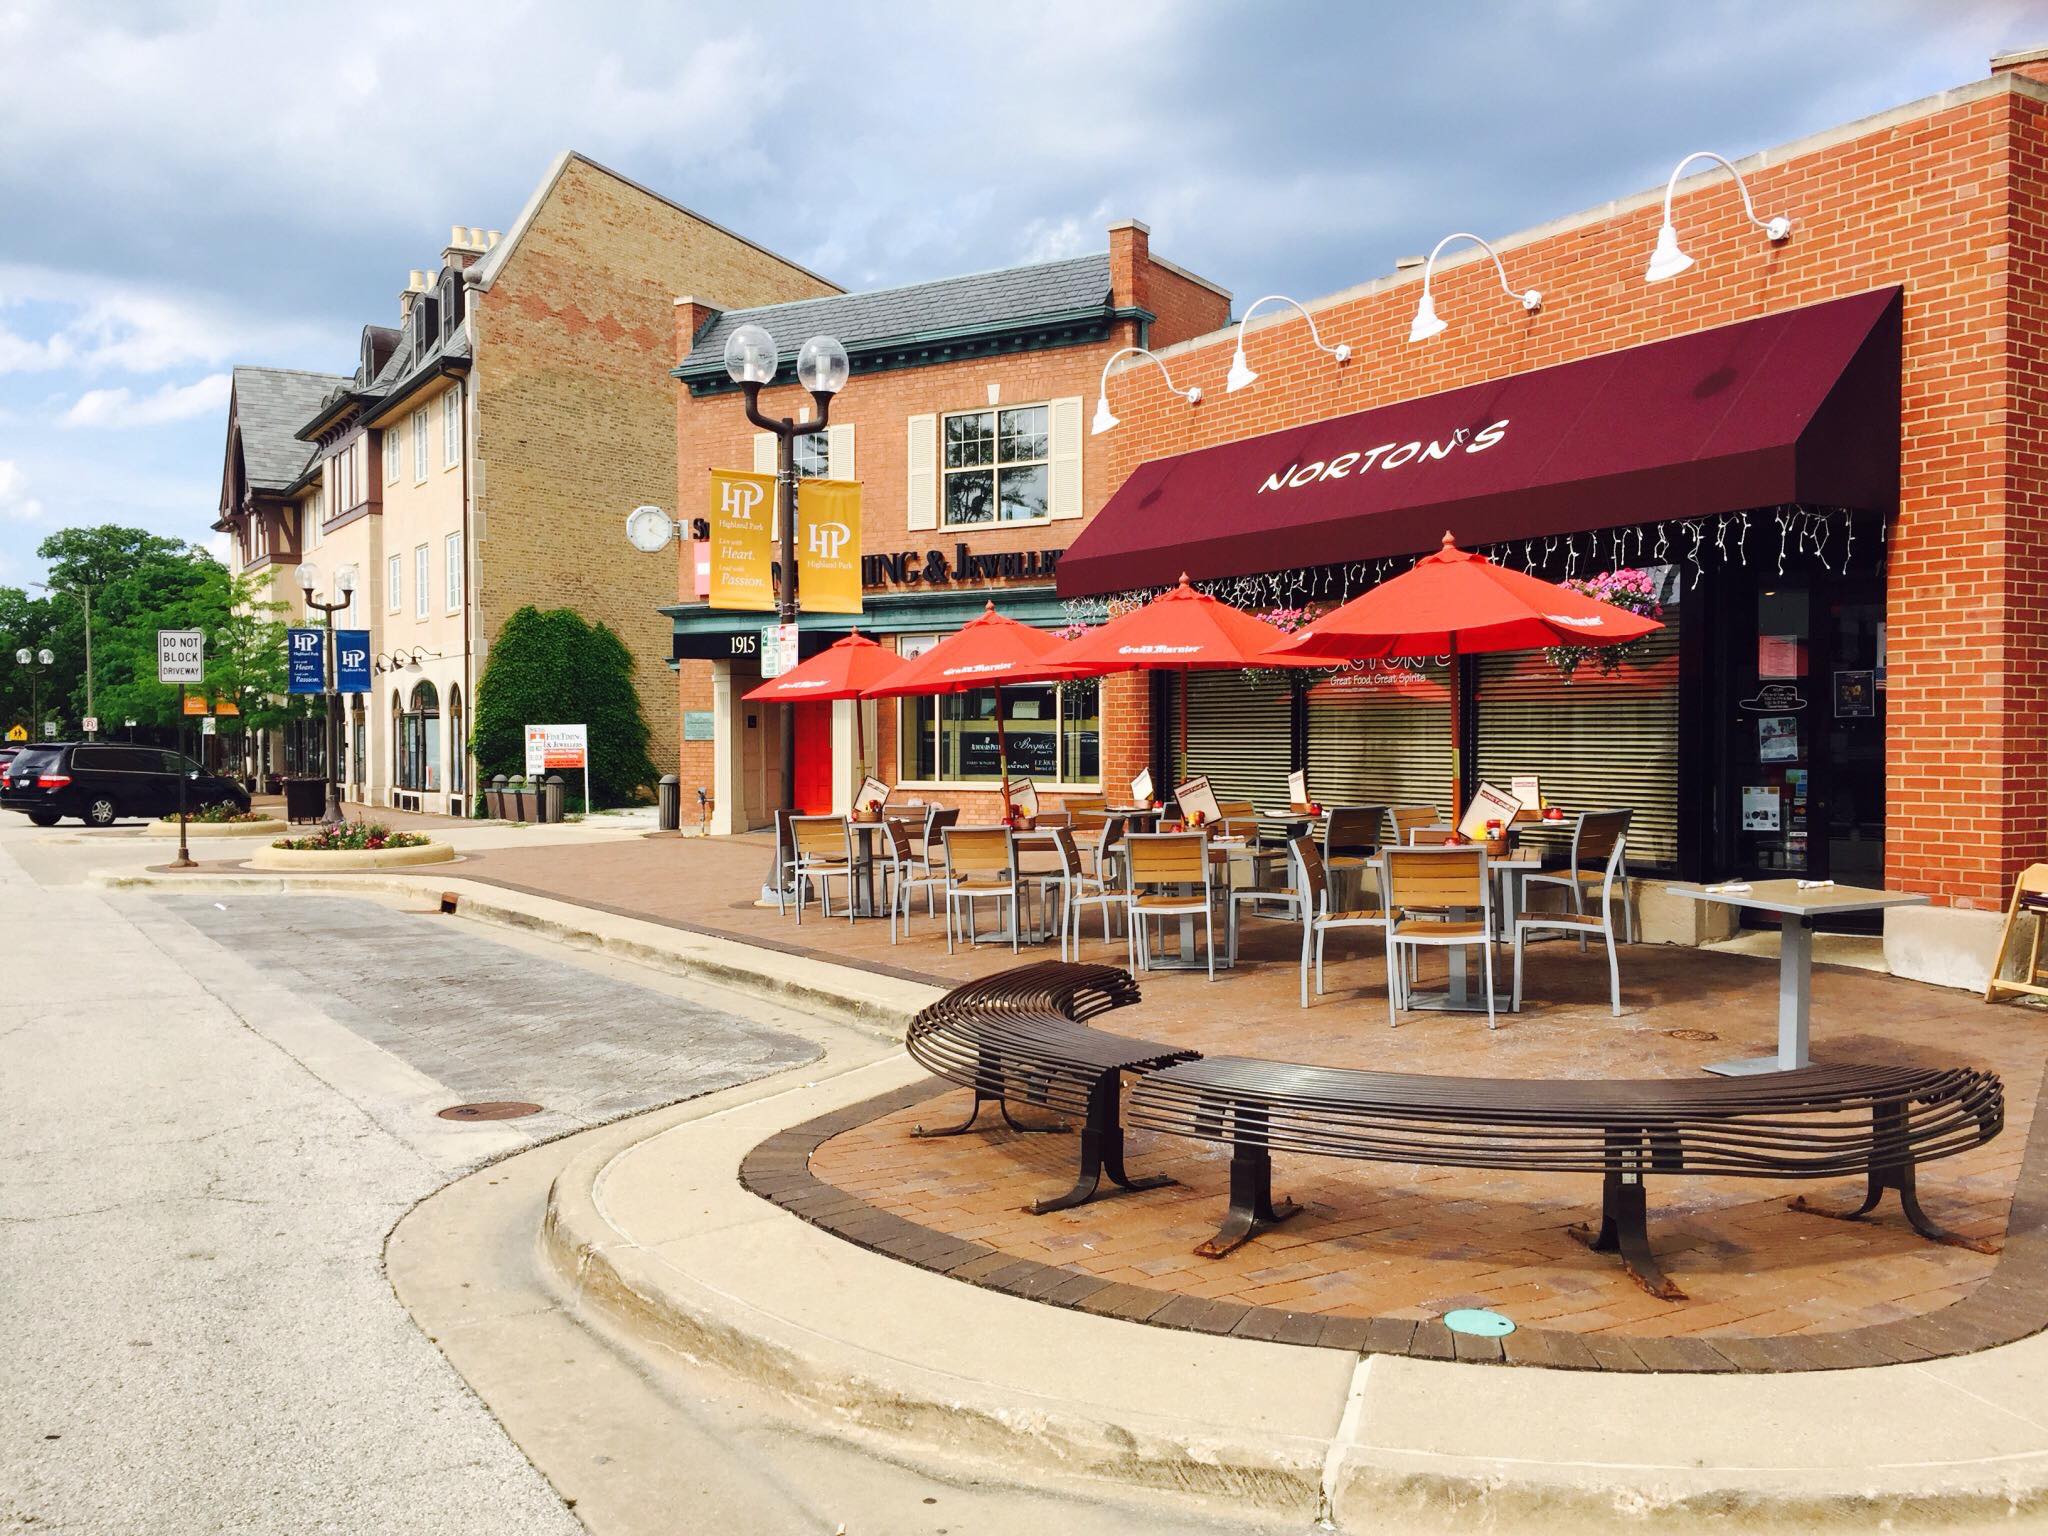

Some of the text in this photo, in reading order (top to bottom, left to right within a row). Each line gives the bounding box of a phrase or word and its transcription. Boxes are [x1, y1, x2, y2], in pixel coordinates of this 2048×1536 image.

[1257, 419, 1509, 494] NORTON'S
[719, 520, 748, 530] Highland
[748, 522, 764, 531] Park
[721, 547, 755, 560] Heart.
[808, 560, 852, 570] Highland Park
[721, 573, 764, 587] Passion.
[163, 637, 198, 647] DO NOT
[730, 636, 755, 653] 1915
[163, 652, 198, 662] BLOCK
[163, 667, 199, 675] DRIVEWAY
[1330, 672, 1426, 687] Great Food, Great Spirits
